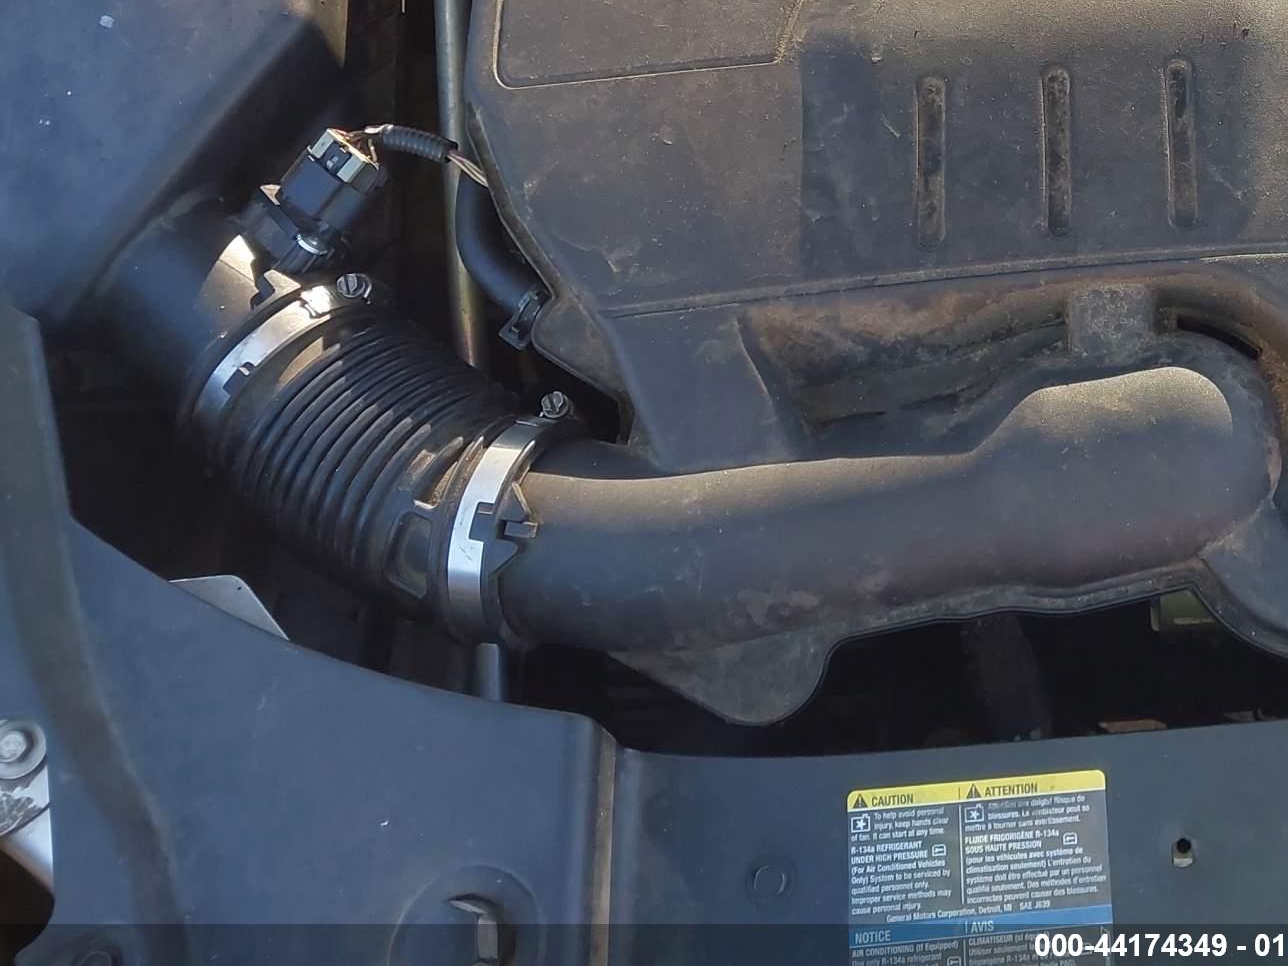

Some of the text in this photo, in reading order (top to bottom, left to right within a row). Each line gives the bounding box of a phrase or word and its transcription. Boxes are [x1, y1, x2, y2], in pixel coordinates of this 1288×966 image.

[985, 783, 1038, 796] ATTENTION
[872, 794, 913, 807] CAUTION
[883, 811, 896, 820] help
[898, 810, 915, 818] avoid
[917, 807, 944, 818] personal
[895, 820, 910, 829] keep
[933, 817, 949, 825] clear
[851, 834, 858, 842] of
[892, 830, 907, 838] start
[916, 829, 928, 838] any
[965, 835, 988, 844] FLUIDE
[1035, 829, 1059, 839] R-134a
[851, 841, 922, 855] R-134a REFRIGERANT
[965, 840, 1042, 854] SOUS HAUTE PRESSION
[851, 850, 928, 864] UNDER HIGH PRESSURE
[966, 856, 983, 865] (pour
[996, 851, 1028, 862] véhicules
[1075, 847, 1083, 855] de
[851, 859, 945, 875] (For Air Conditioned Vehicles
[966, 863, 1008, 874] climatisation
[994, 873, 1006, 881] doit
[1050, 868, 1059, 877] par
[1062, 868, 1070, 876] un
[1071, 865, 1102, 876] personnel
[870, 874, 894, 884] System
[913, 869, 941, 879] serviced
[943, 869, 950, 878] by
[851, 885, 879, 896] qualified
[881, 882, 913, 892] personnel
[1027, 880, 1039, 889] Des
[851, 889, 951, 905] Improper service methods may
[967, 893, 1002, 904] incorrectes
[1004, 891, 1030, 902] peuvent
[1031, 890, 1052, 898] causer
[1054, 888, 1065, 896] des
[852, 906, 871, 914] cause
[872, 903, 901, 914] personal
[887, 914, 912, 922] General
[913, 911, 936, 920] Motors
[1004, 903, 1012, 912] MI
[1020, 902, 1032, 910] SAE
[971, 920, 994, 933] AVIS
[855, 930, 891, 944] NOTICE
[852, 950, 864, 958] AIR
[866, 944, 914, 956] CONDITIONING
[925, 940, 958, 952] Equipped)
[881, 956, 905, 965] R-134a
